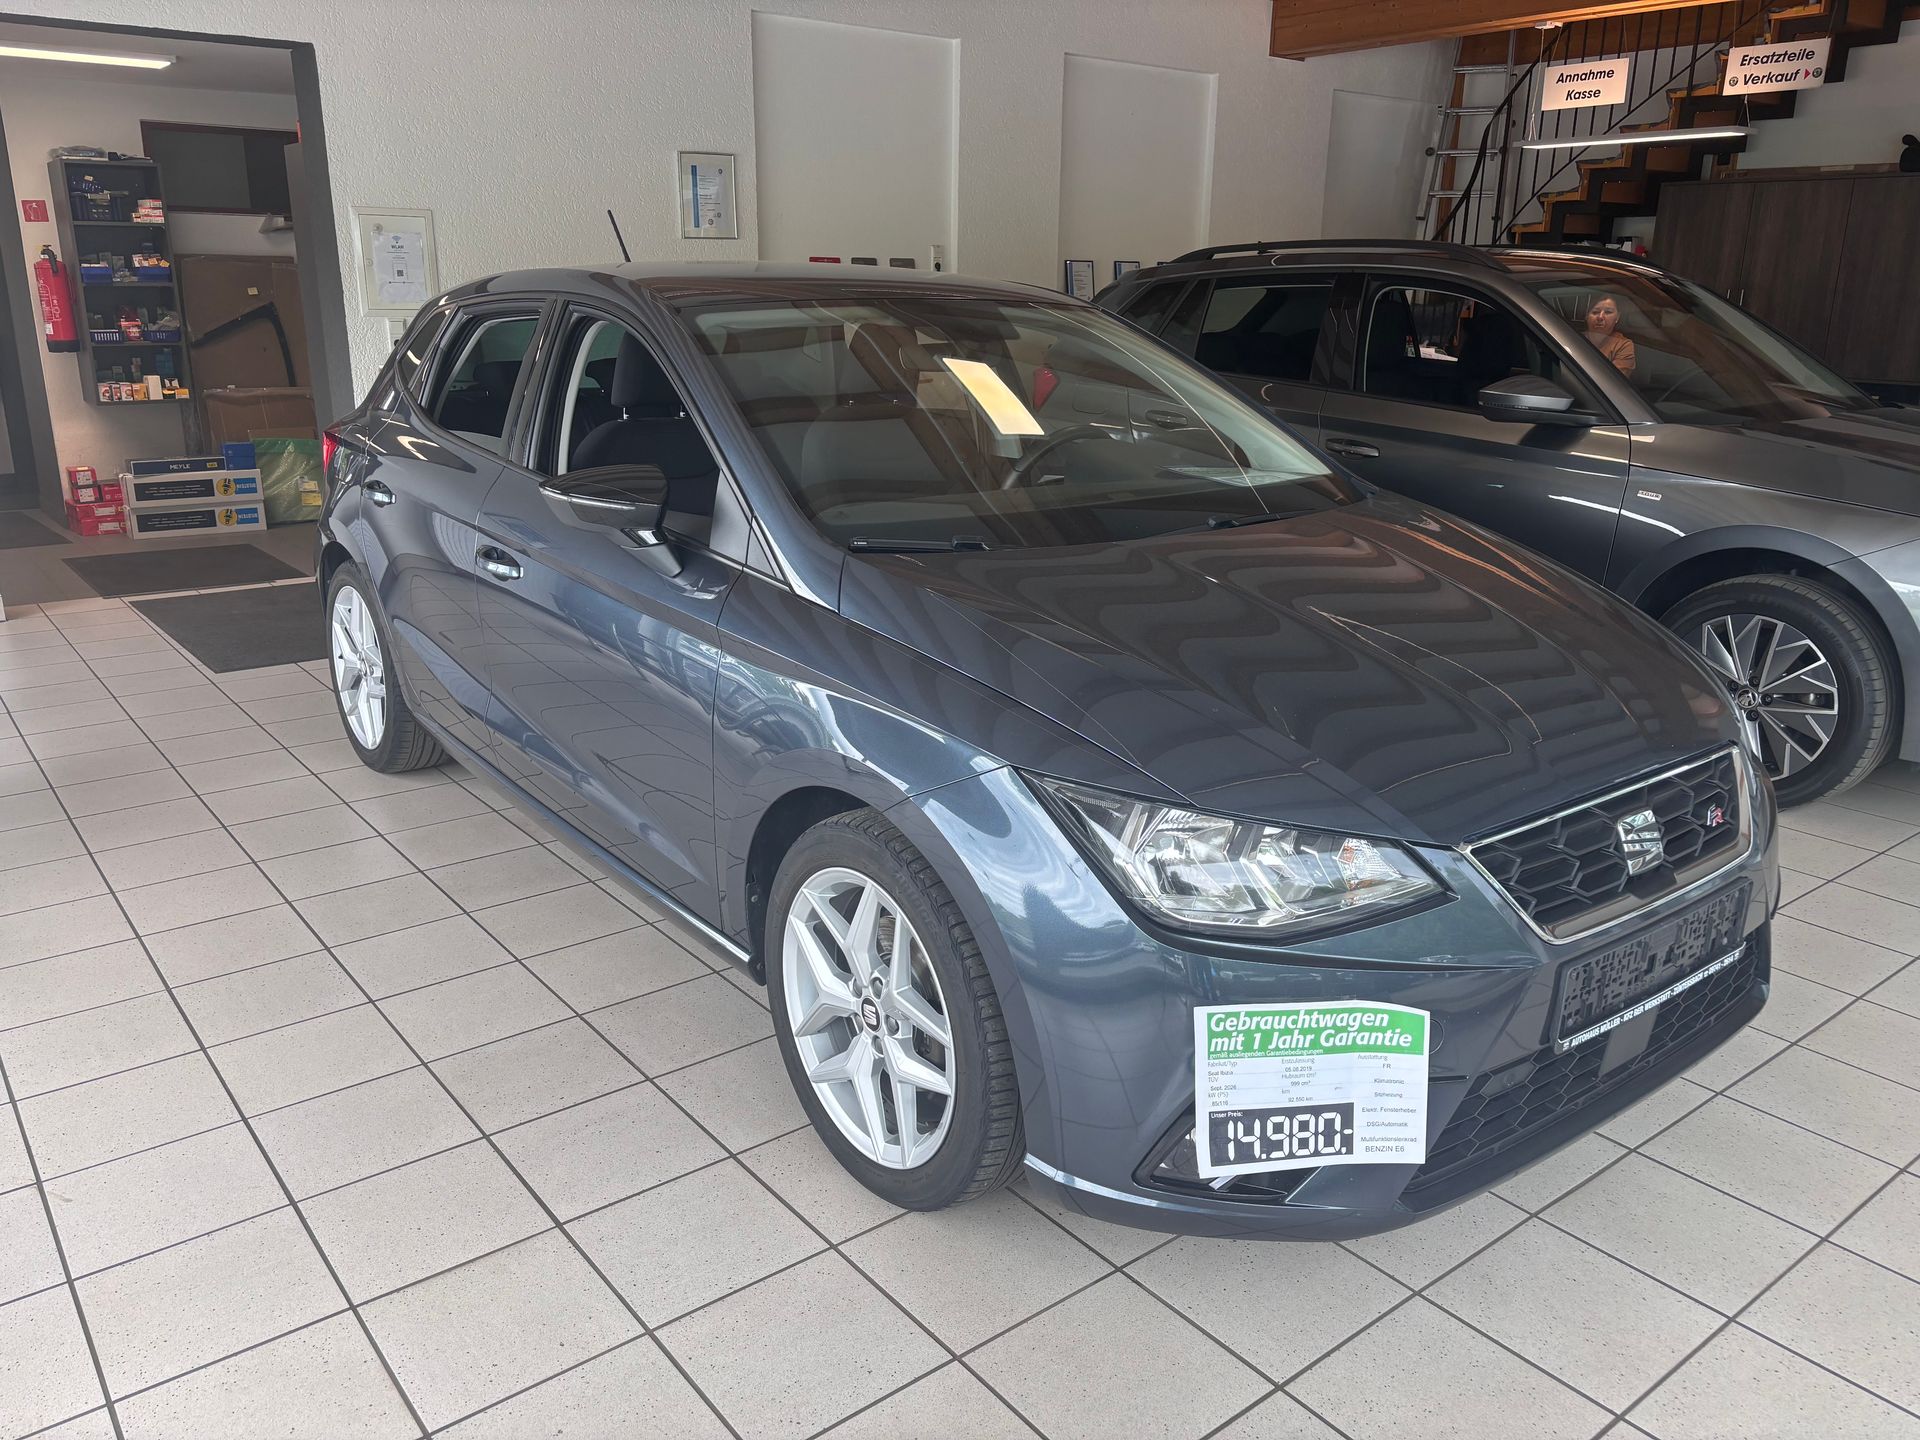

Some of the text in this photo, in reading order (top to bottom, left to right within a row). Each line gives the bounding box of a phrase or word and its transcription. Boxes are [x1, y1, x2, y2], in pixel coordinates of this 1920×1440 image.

[1740, 48, 1815, 67] Ersatzteile
[1556, 69, 1615, 84] Annahme
[1743, 69, 1801, 85] Verkauf
[1565, 89, 1601, 101] Kasse
[1210, 1009, 1389, 1032] Gebrauchtwagen
[1571, 1026, 1601, 1048] AUTOHAUS
[1600, 1016, 1622, 1034] MÜLLER
[1210, 1028, 1413, 1052] mit 1 Jahr Garantie
[1266, 1048, 1324, 1057] Garantiebedingungen
[1210, 1110, 1244, 1119] Unser Preis:
[1364, 1145, 1405, 1153] BENZIN E6
